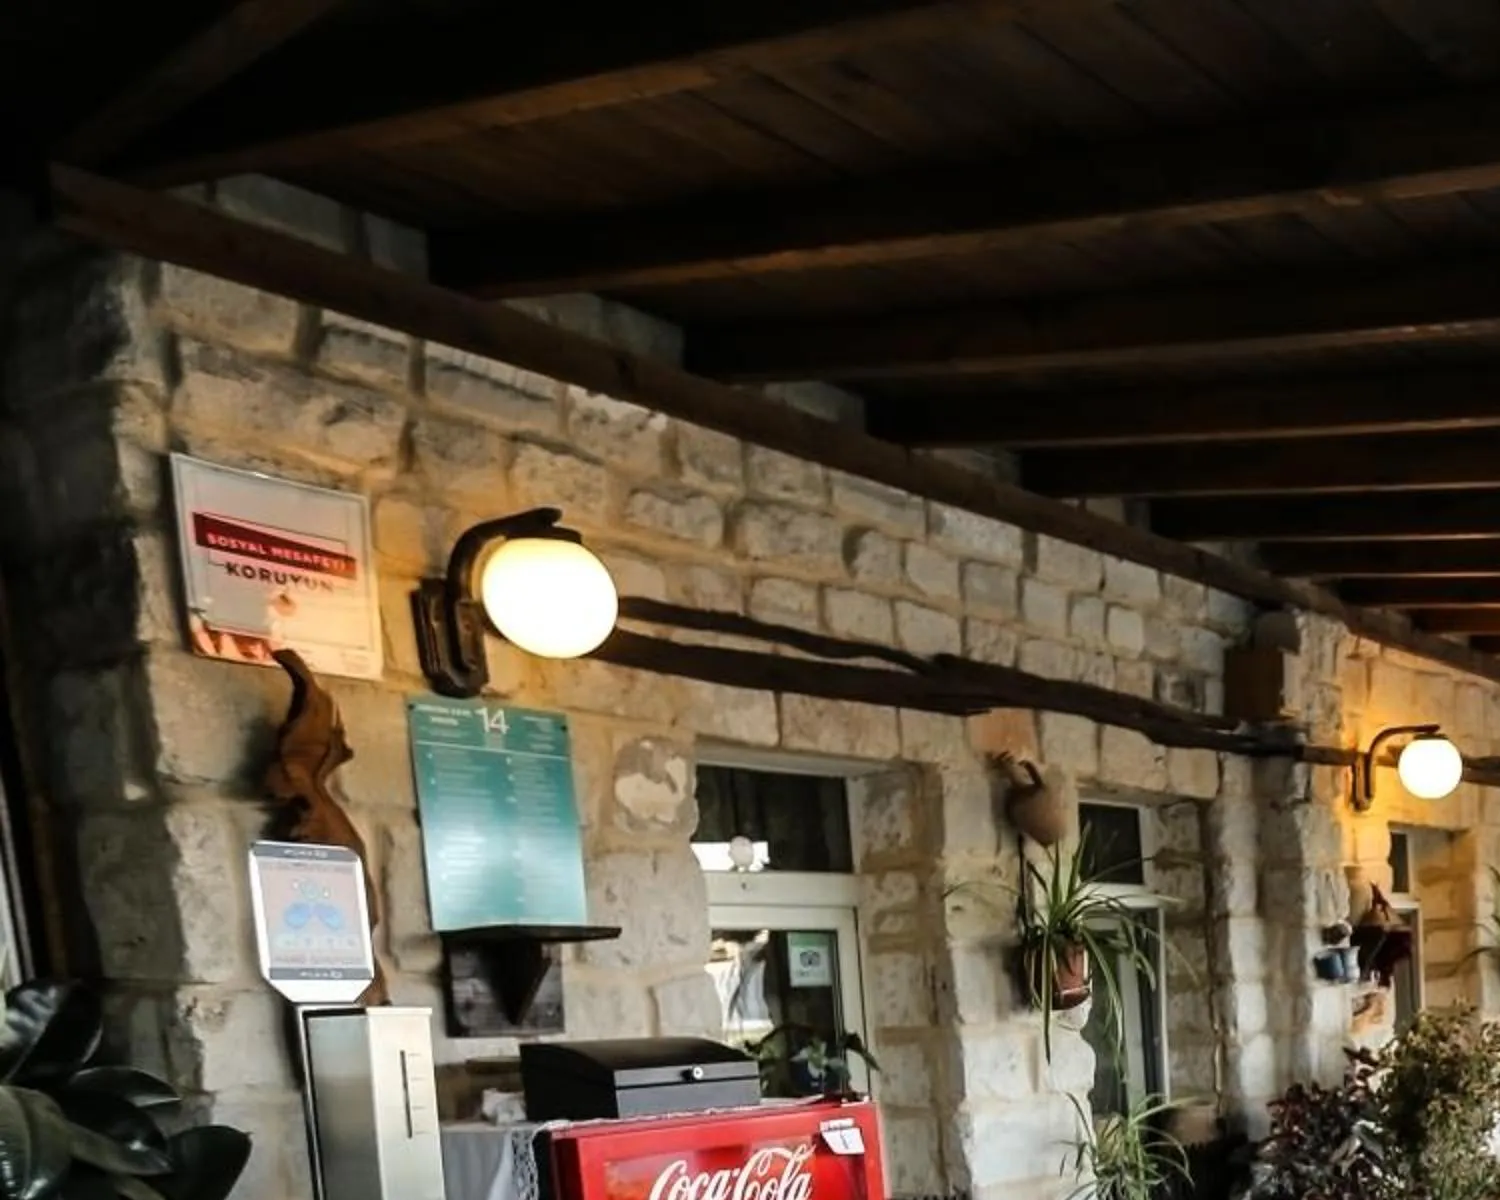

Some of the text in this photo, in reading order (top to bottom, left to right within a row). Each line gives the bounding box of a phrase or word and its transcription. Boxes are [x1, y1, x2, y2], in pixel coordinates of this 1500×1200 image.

[206, 531, 267, 556] SOSYAL
[224, 561, 334, 593] KORUYUN
[474, 706, 511, 735] 14
